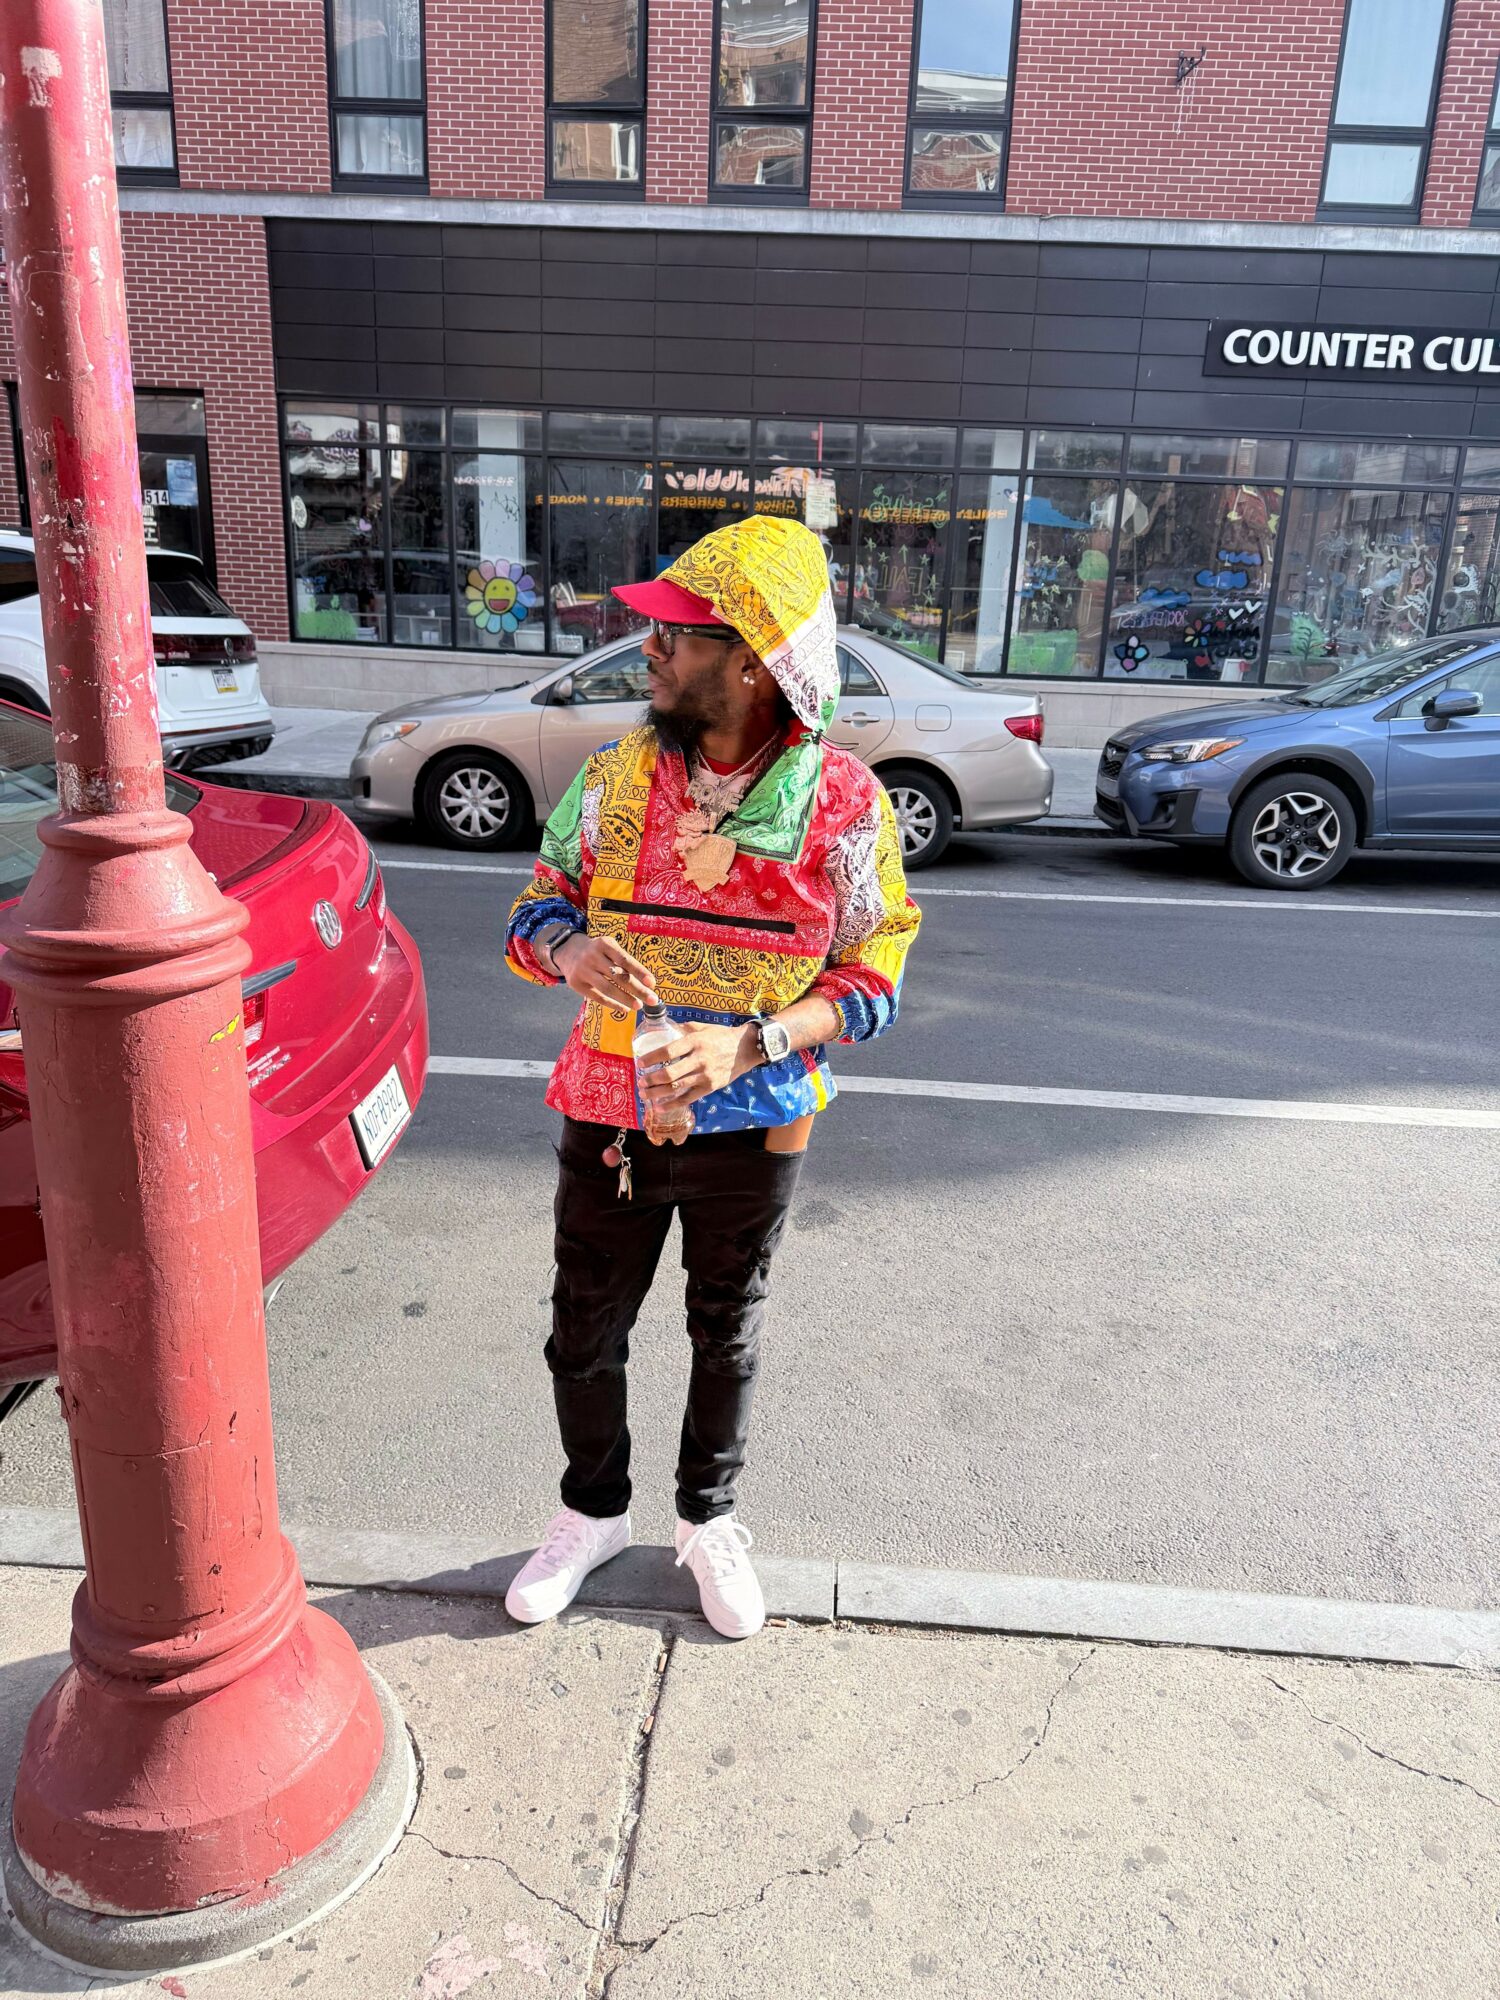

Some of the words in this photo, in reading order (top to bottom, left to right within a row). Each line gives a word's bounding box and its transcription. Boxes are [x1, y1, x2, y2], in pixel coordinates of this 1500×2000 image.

[1222, 328, 1415, 370] COUNTER
[1422, 335, 1500, 373] CUL
[145, 490, 168, 505] 514
